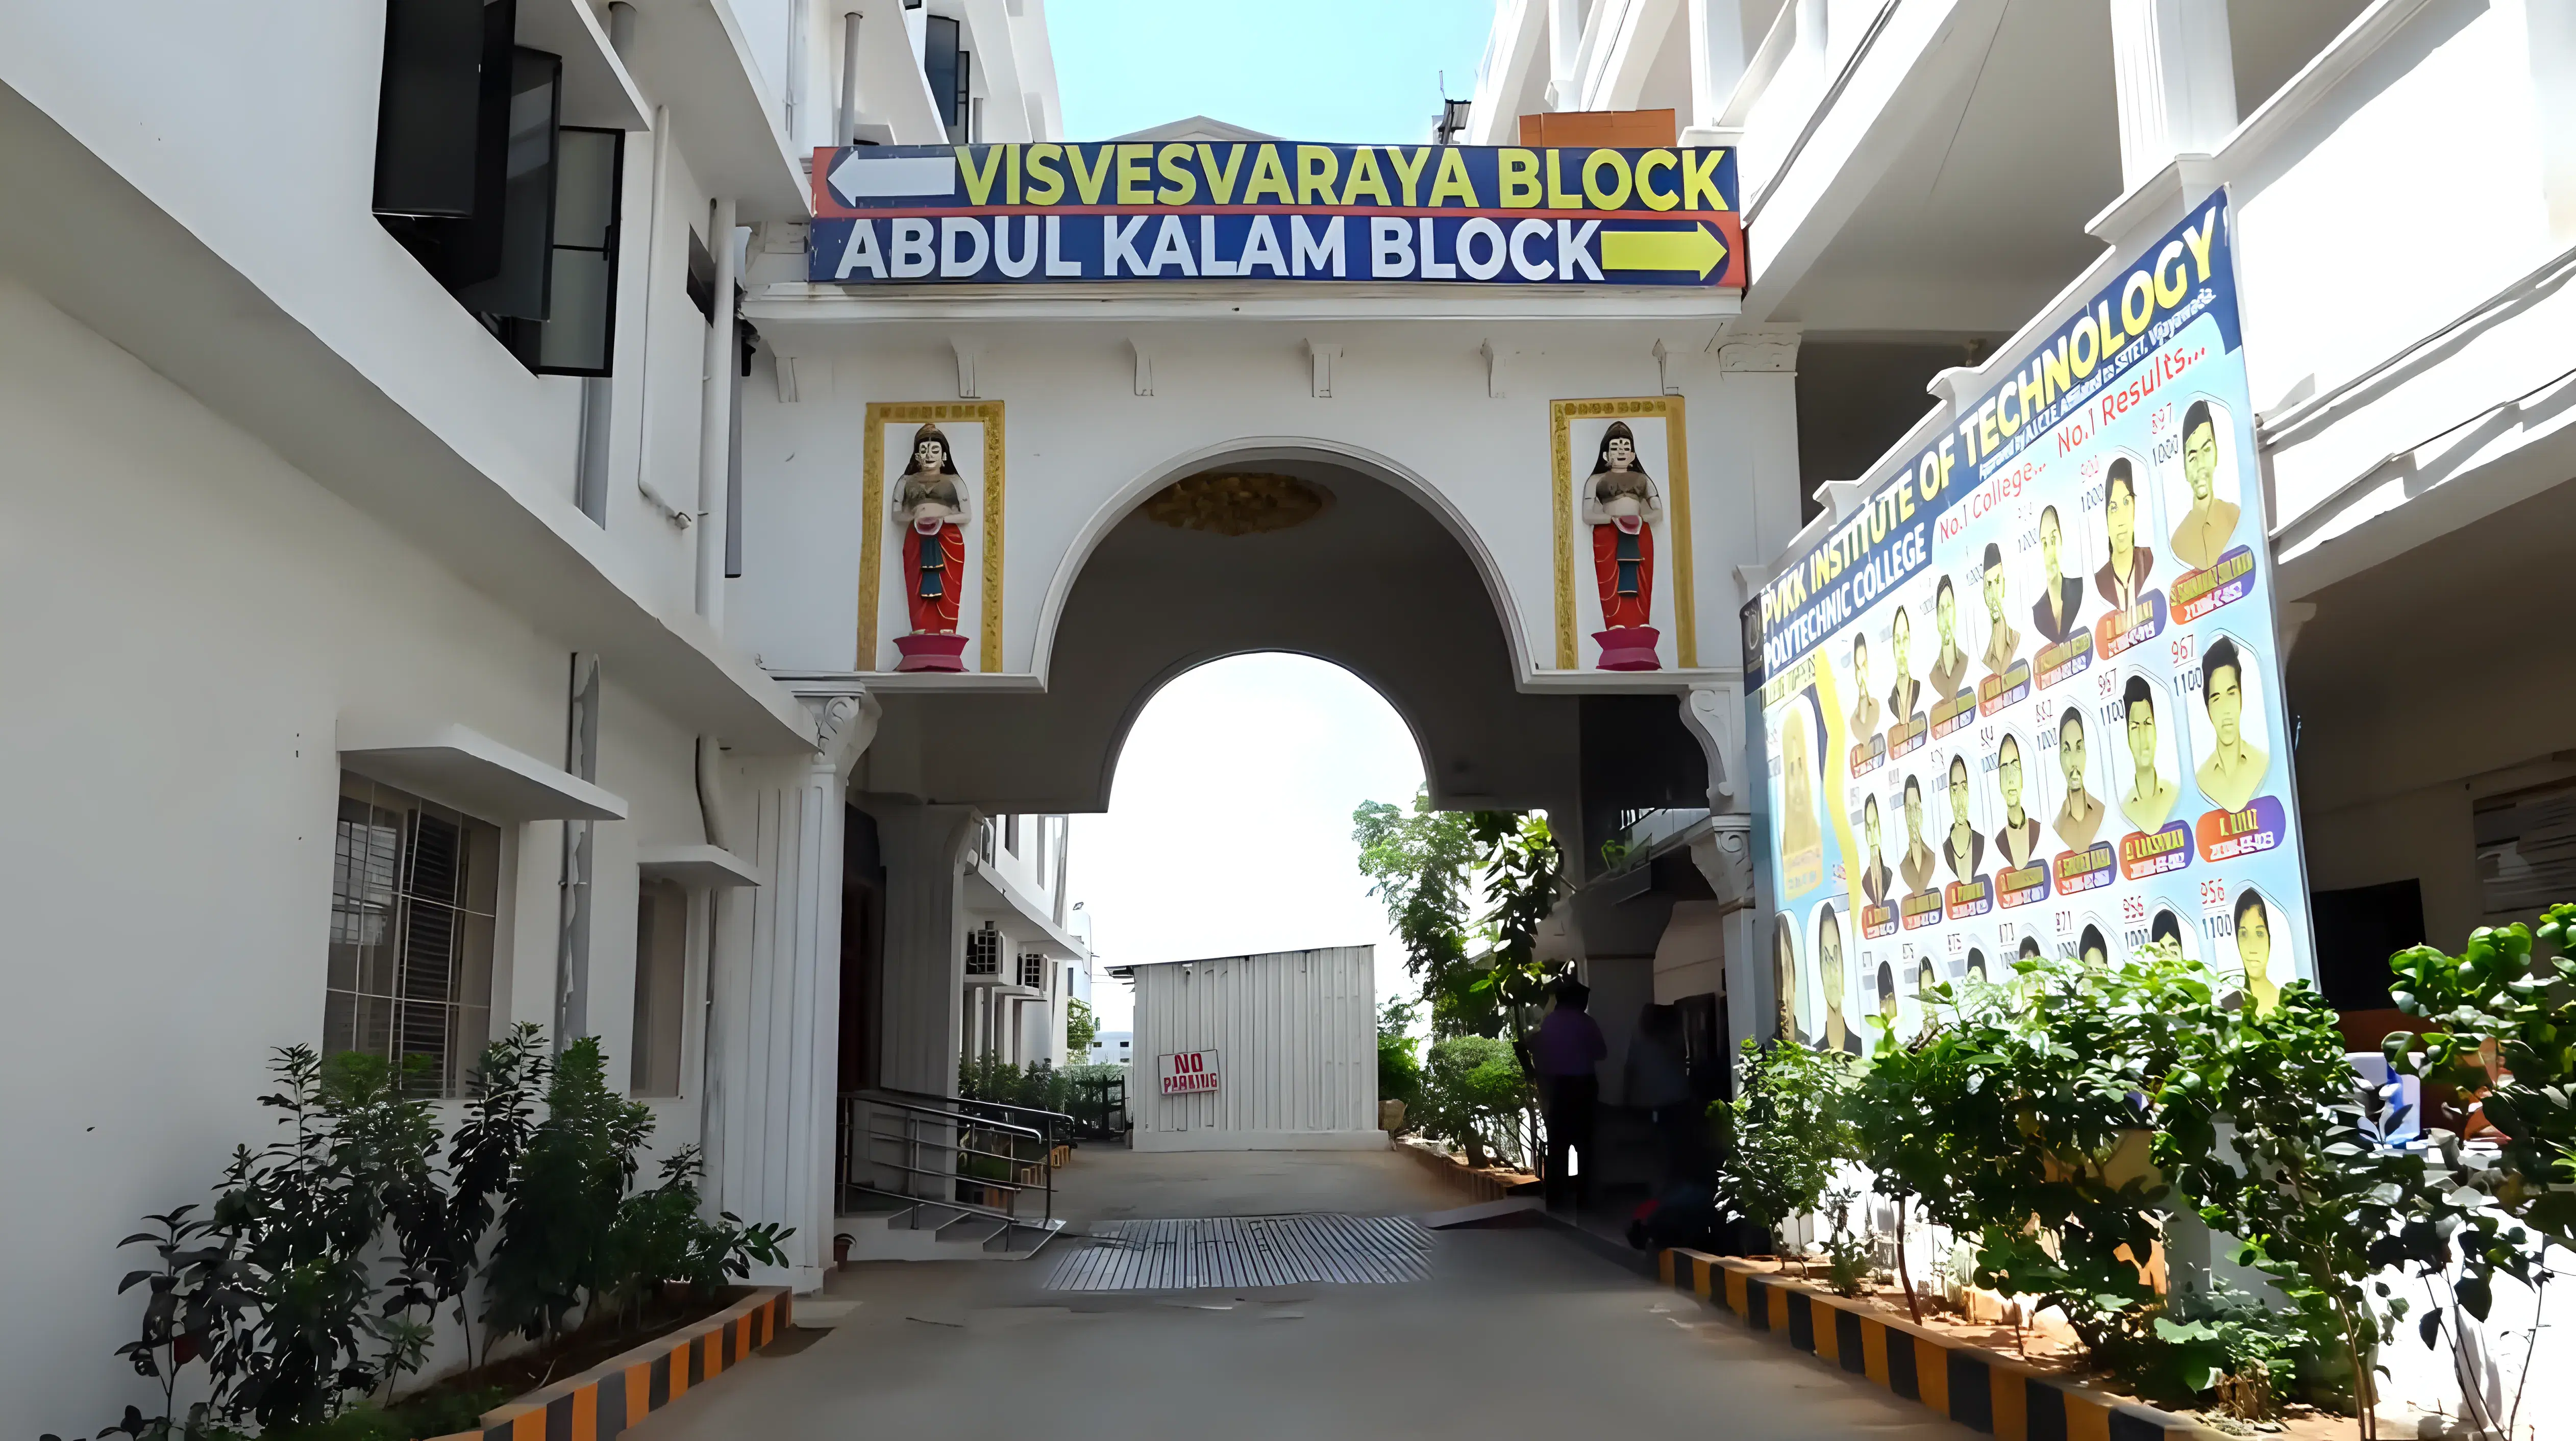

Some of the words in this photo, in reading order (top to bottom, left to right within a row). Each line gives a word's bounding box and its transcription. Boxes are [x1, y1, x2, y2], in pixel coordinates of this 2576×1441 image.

[953, 143, 1480, 207] VISVESVARAYA
[1498, 148, 1729, 211] BLOCK
[835, 215, 1081, 279] ABDUL
[1104, 214, 1346, 278] KALAM
[1370, 217, 1605, 281] BLOCK
[1761, 562, 1807, 633] PVKK
[1810, 468, 1915, 594] INSTITUTE
[1920, 432, 1955, 502] OF
[1959, 206, 2216, 467] TECHNOLOGY
[2058, 408, 2095, 458] No.1
[2102, 347, 2206, 426] Results...
[1940, 504, 1967, 543] No.1
[1973, 462, 2046, 518] College...
[1764, 581, 1851, 680] POLYTECHNIC
[1853, 522, 1926, 608] COLLEGE
[2172, 634, 2194, 663] 967
[2174, 667, 2202, 697] 1100
[2201, 878, 2224, 904] 956
[2202, 914, 2232, 939] 1100
[1163, 1073, 1217, 1092] PARKING
[1175, 1053, 1203, 1074] NO
